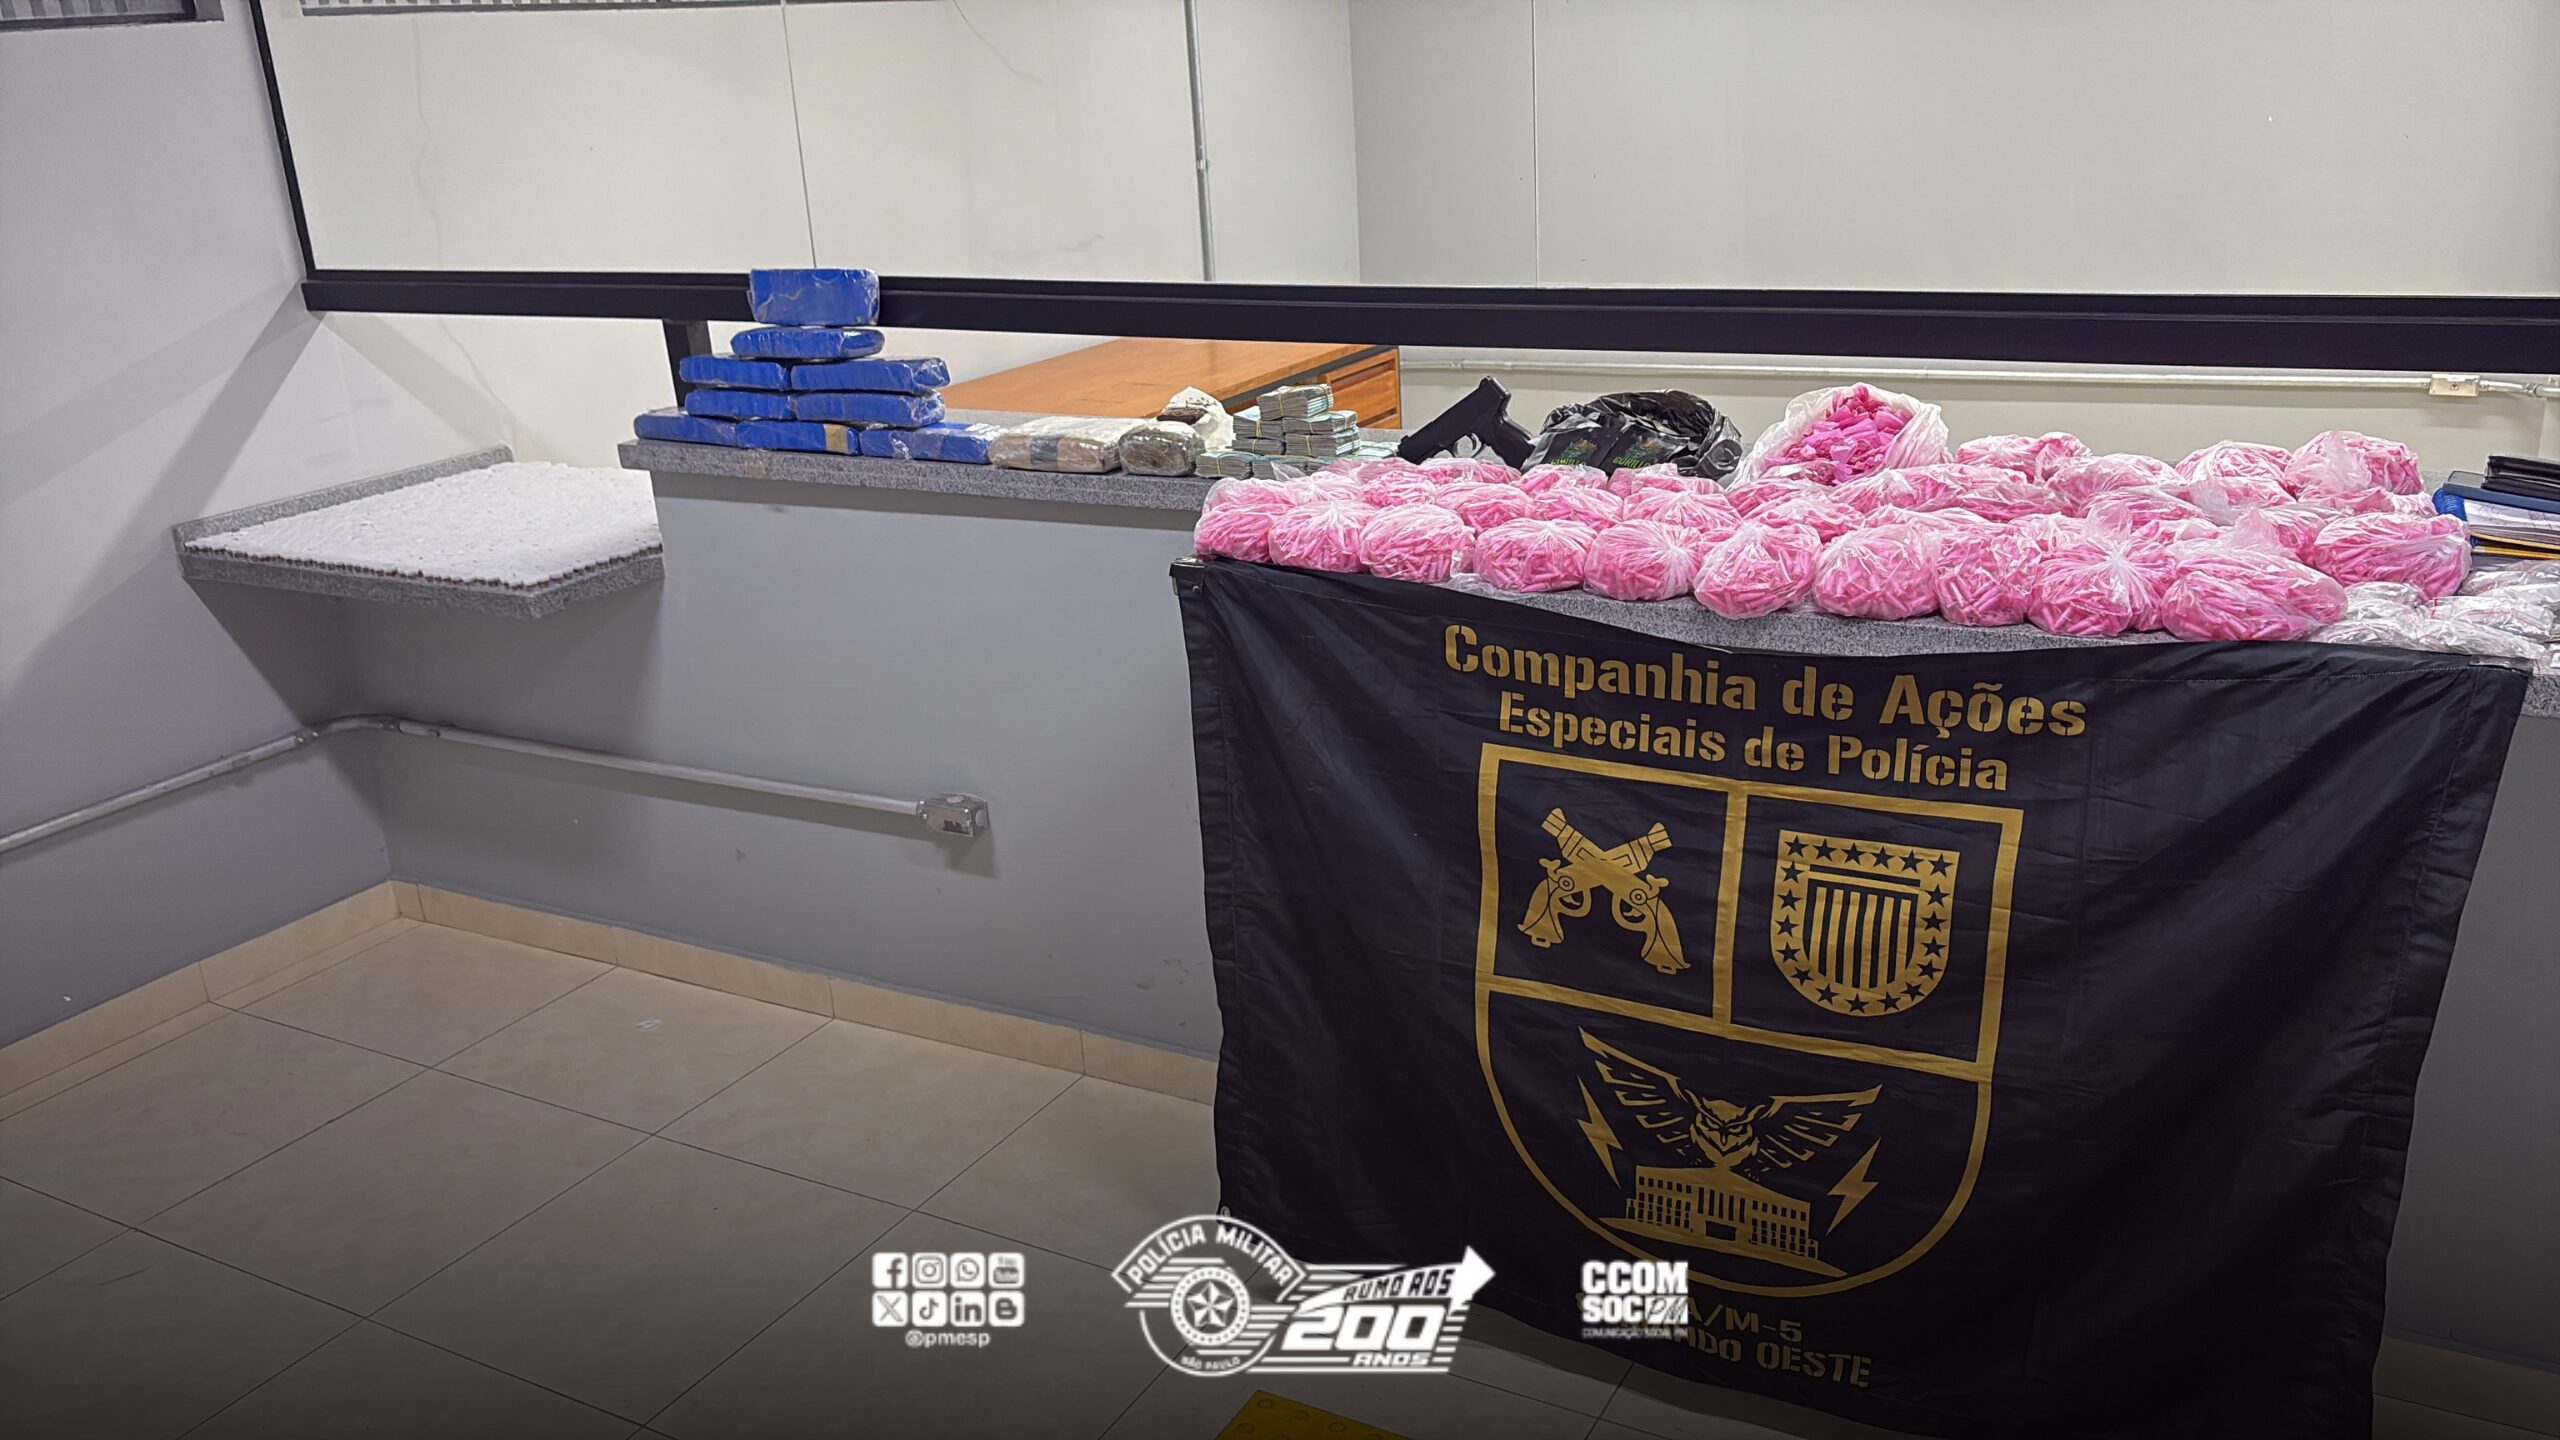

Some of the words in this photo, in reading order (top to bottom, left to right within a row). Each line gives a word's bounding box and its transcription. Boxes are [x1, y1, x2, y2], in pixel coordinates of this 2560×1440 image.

[1445, 624, 1756, 711] Companhia
[1782, 667, 1853, 721] de
[1879, 675, 2087, 739] Ações
[1499, 691, 1726, 763] Especiais
[1744, 726, 1805, 772] de
[1828, 735, 2008, 792] Polícia
[1756, 1341, 1873, 1388] OESTE
